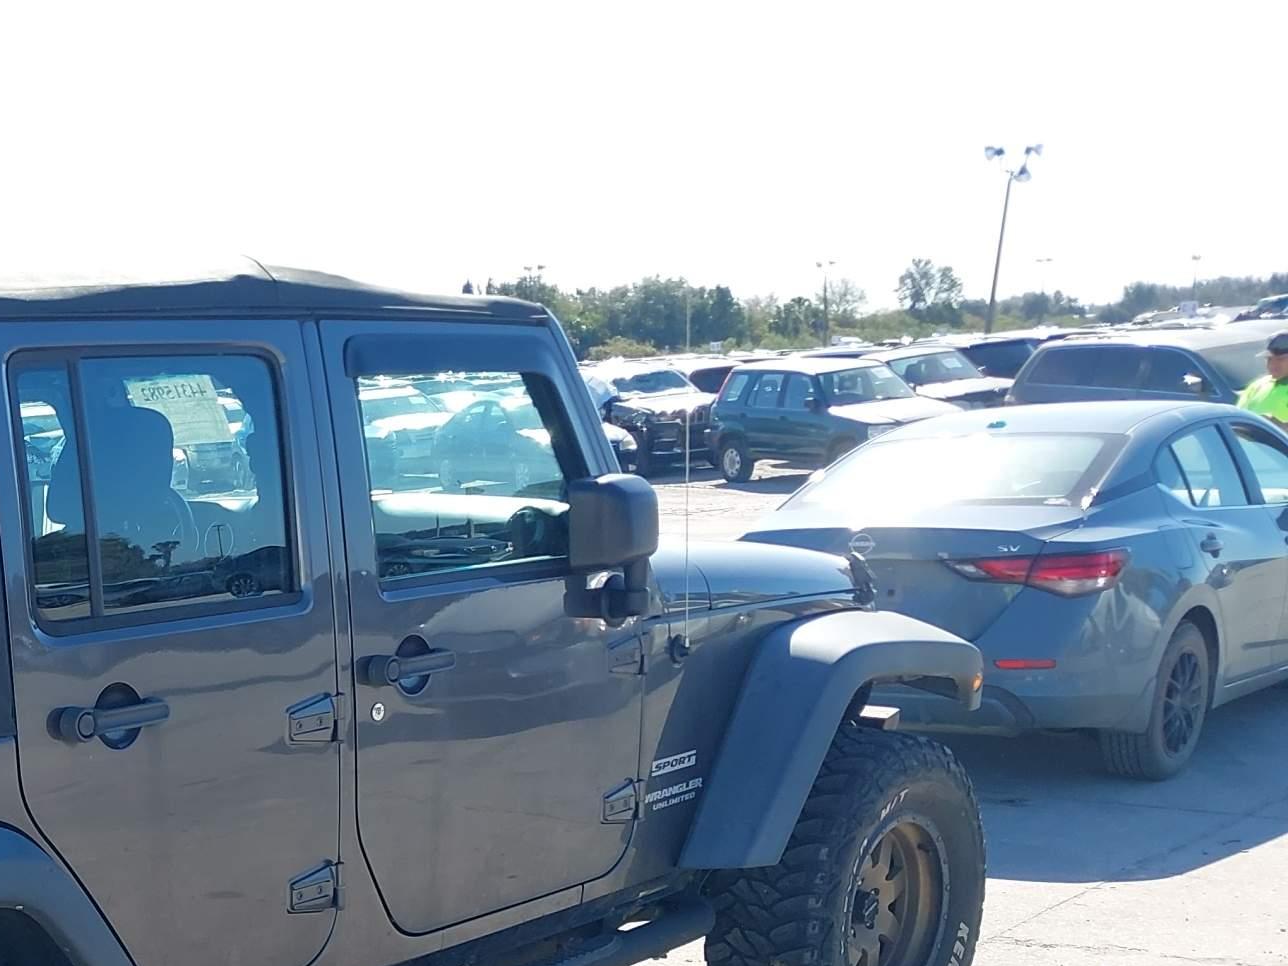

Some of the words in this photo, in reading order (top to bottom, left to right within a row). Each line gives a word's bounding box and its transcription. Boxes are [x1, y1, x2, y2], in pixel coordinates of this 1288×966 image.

[997, 544, 1021, 553] SV
[653, 754, 695, 772] SPORT
[645, 777, 703, 804] WRANGLER
[653, 791, 696, 811] UNLIMITED
